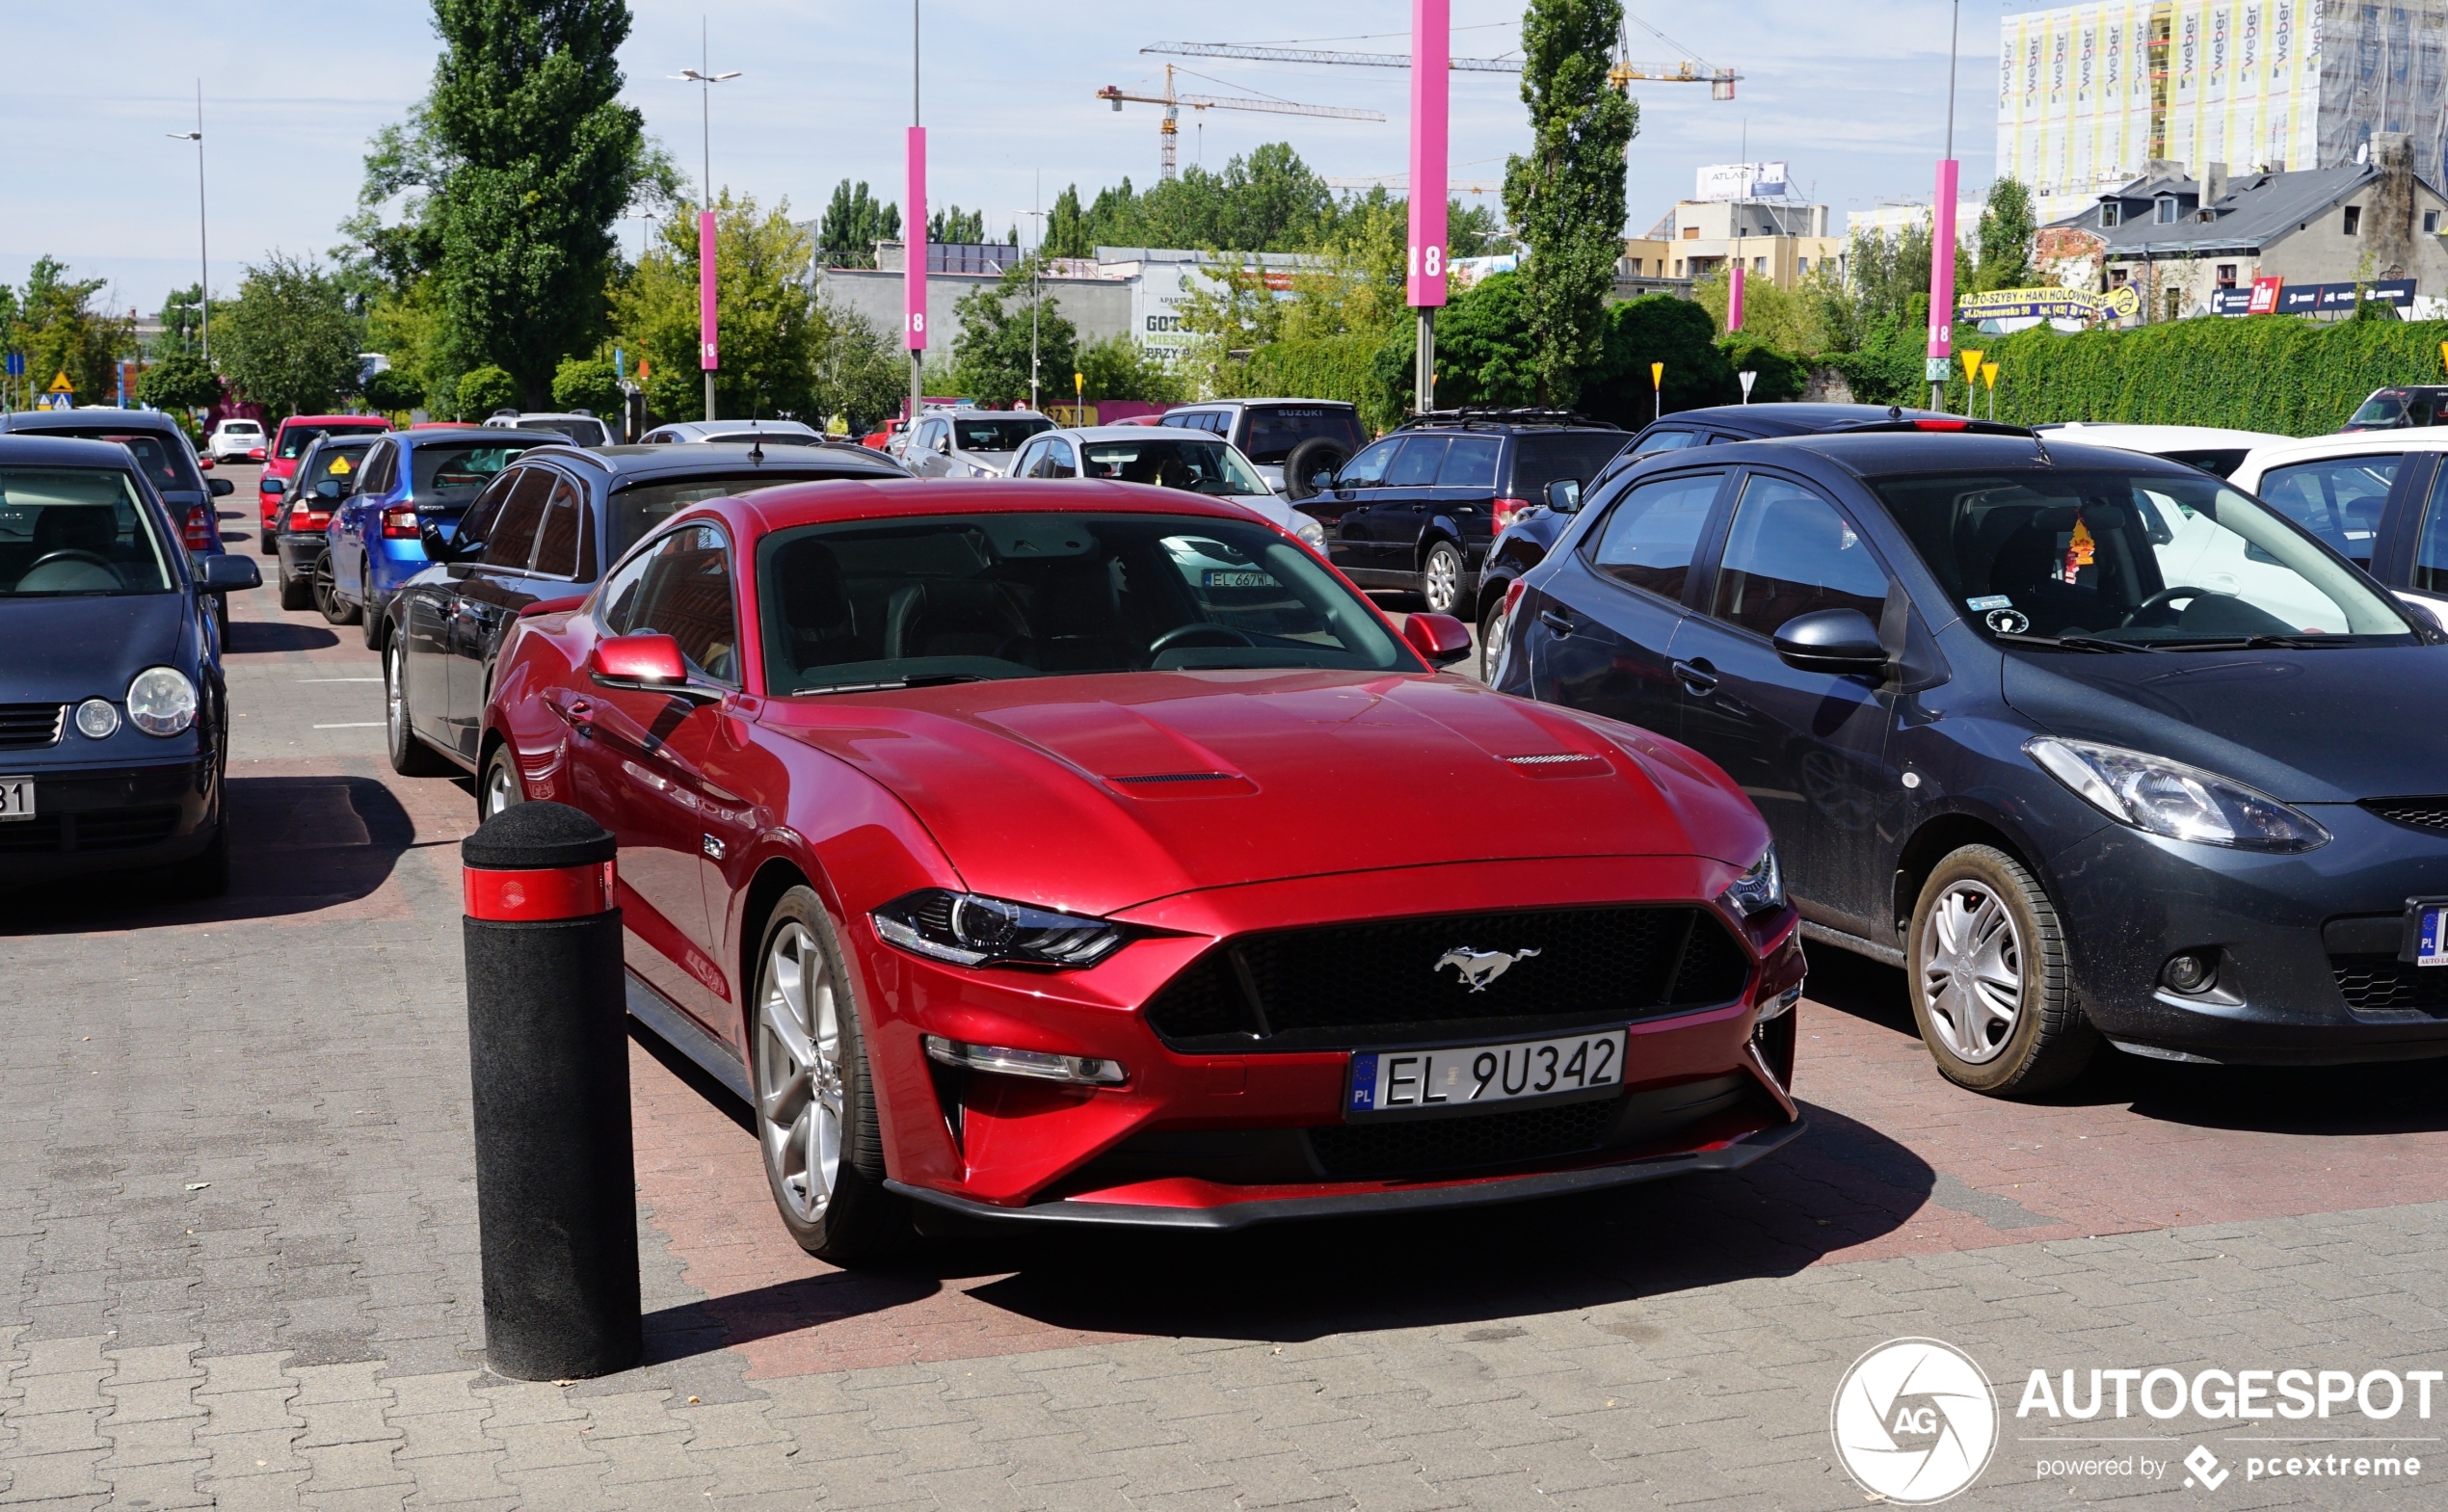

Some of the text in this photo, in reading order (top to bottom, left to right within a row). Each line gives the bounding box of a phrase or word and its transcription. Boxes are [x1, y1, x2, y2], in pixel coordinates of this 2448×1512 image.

[2183, 15, 2195, 74] weber
[2213, 11, 2225, 71] weber
[2244, 6, 2256, 67] weber
[2276, 2, 2289, 64] weber
[2027, 38, 2038, 94] weber
[2054, 34, 2064, 91] weber
[2081, 30, 2092, 88] weber
[2107, 27, 2119, 84] weber
[1712, 172, 1748, 181] ATLAS
[1425, 246, 1440, 277] 8
[2021, 305, 2031, 315] 50
[2026, 290, 2046, 301] HAKI
[1145, 348, 1178, 359] PRZY
[1940, 326, 1949, 342] 8
[1214, 573, 1230, 586] EL
[2421, 939, 2434, 948] PL
[1385, 1038, 1615, 1105] EL 9U342
[1354, 1090, 1371, 1103] PL
